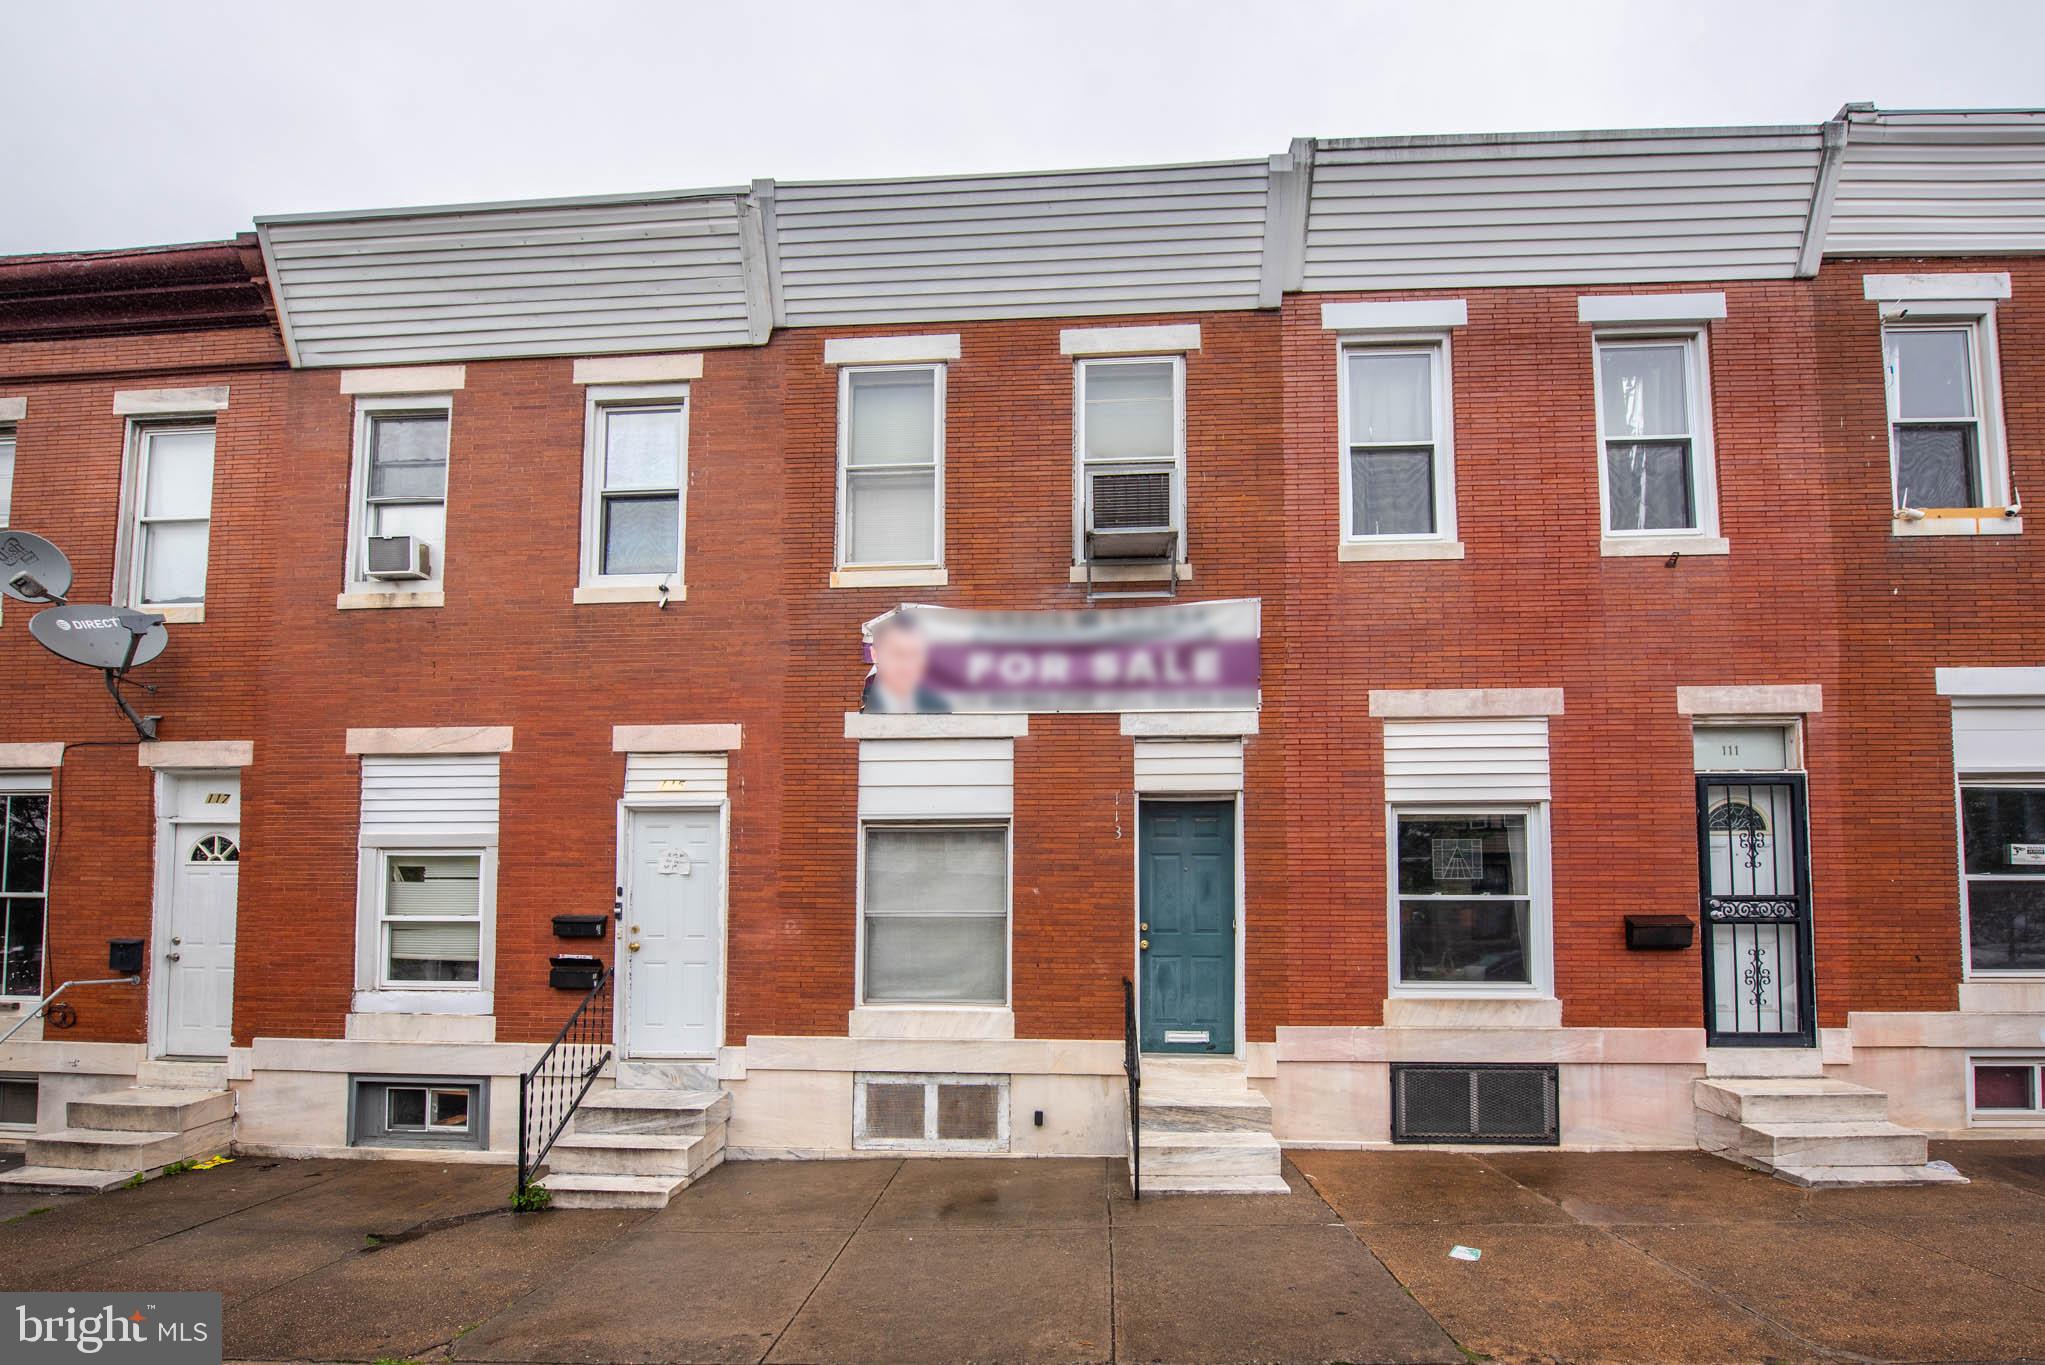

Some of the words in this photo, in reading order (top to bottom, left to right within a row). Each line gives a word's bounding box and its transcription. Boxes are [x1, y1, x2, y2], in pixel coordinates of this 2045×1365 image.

[71, 617, 120, 630] DIRECT
[1722, 745, 1739, 756] 111
[207, 793, 231, 804] 117
